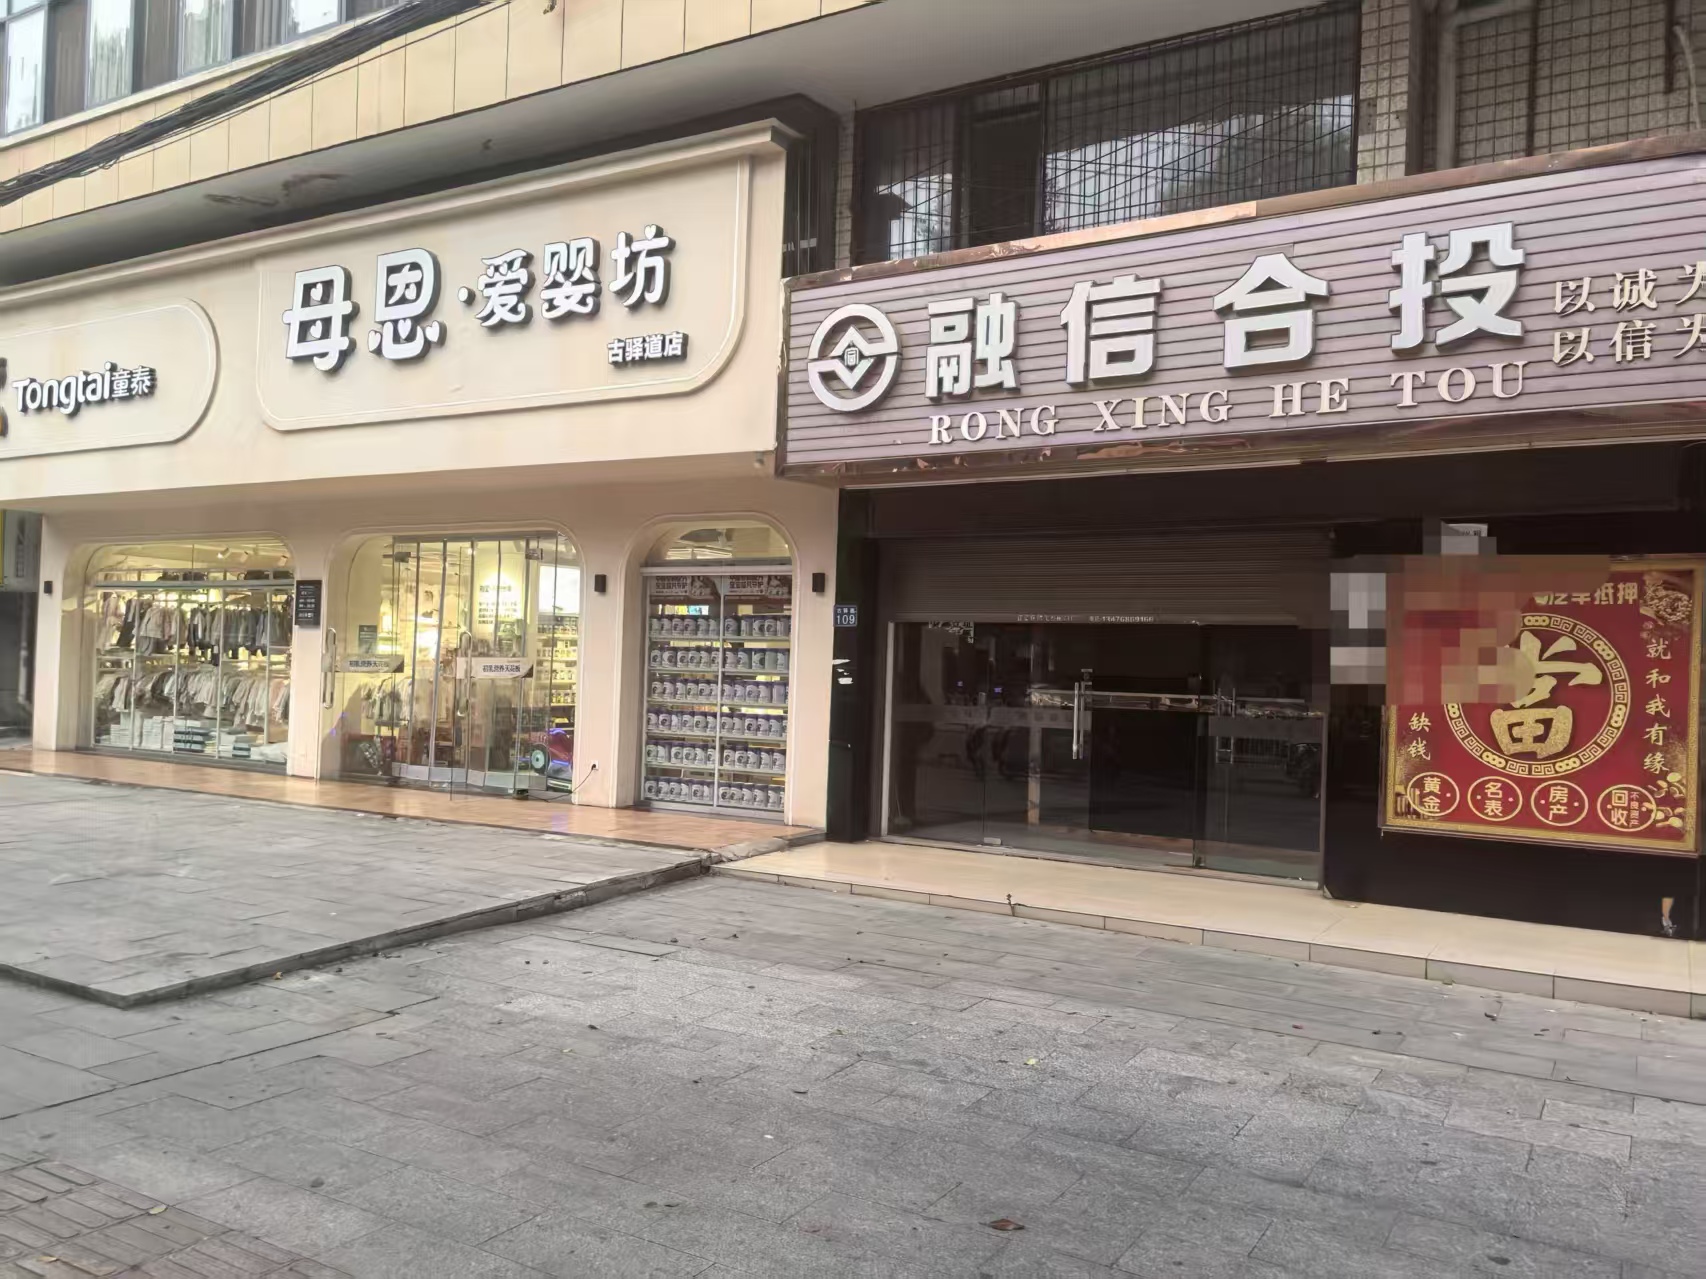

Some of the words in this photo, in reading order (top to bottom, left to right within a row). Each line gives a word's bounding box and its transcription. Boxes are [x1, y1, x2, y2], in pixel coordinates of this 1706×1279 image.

[925, 221, 1526, 401] 融信合投
[607, 331, 688, 365] 古驿道店
[928, 405, 1060, 445] RONG
[1093, 389, 1234, 432] XING
[1268, 377, 1350, 418] HE
[1390, 360, 1529, 408] TOU
[836, 614, 855, 625] 109
[1643, 637, 1671, 774] 就和我有缘
[1422, 776, 1442, 813] 黄金
[1484, 781, 1504, 817] 名表
[1549, 785, 1569, 821] 房产
[1610, 789, 1629, 827] 回收
